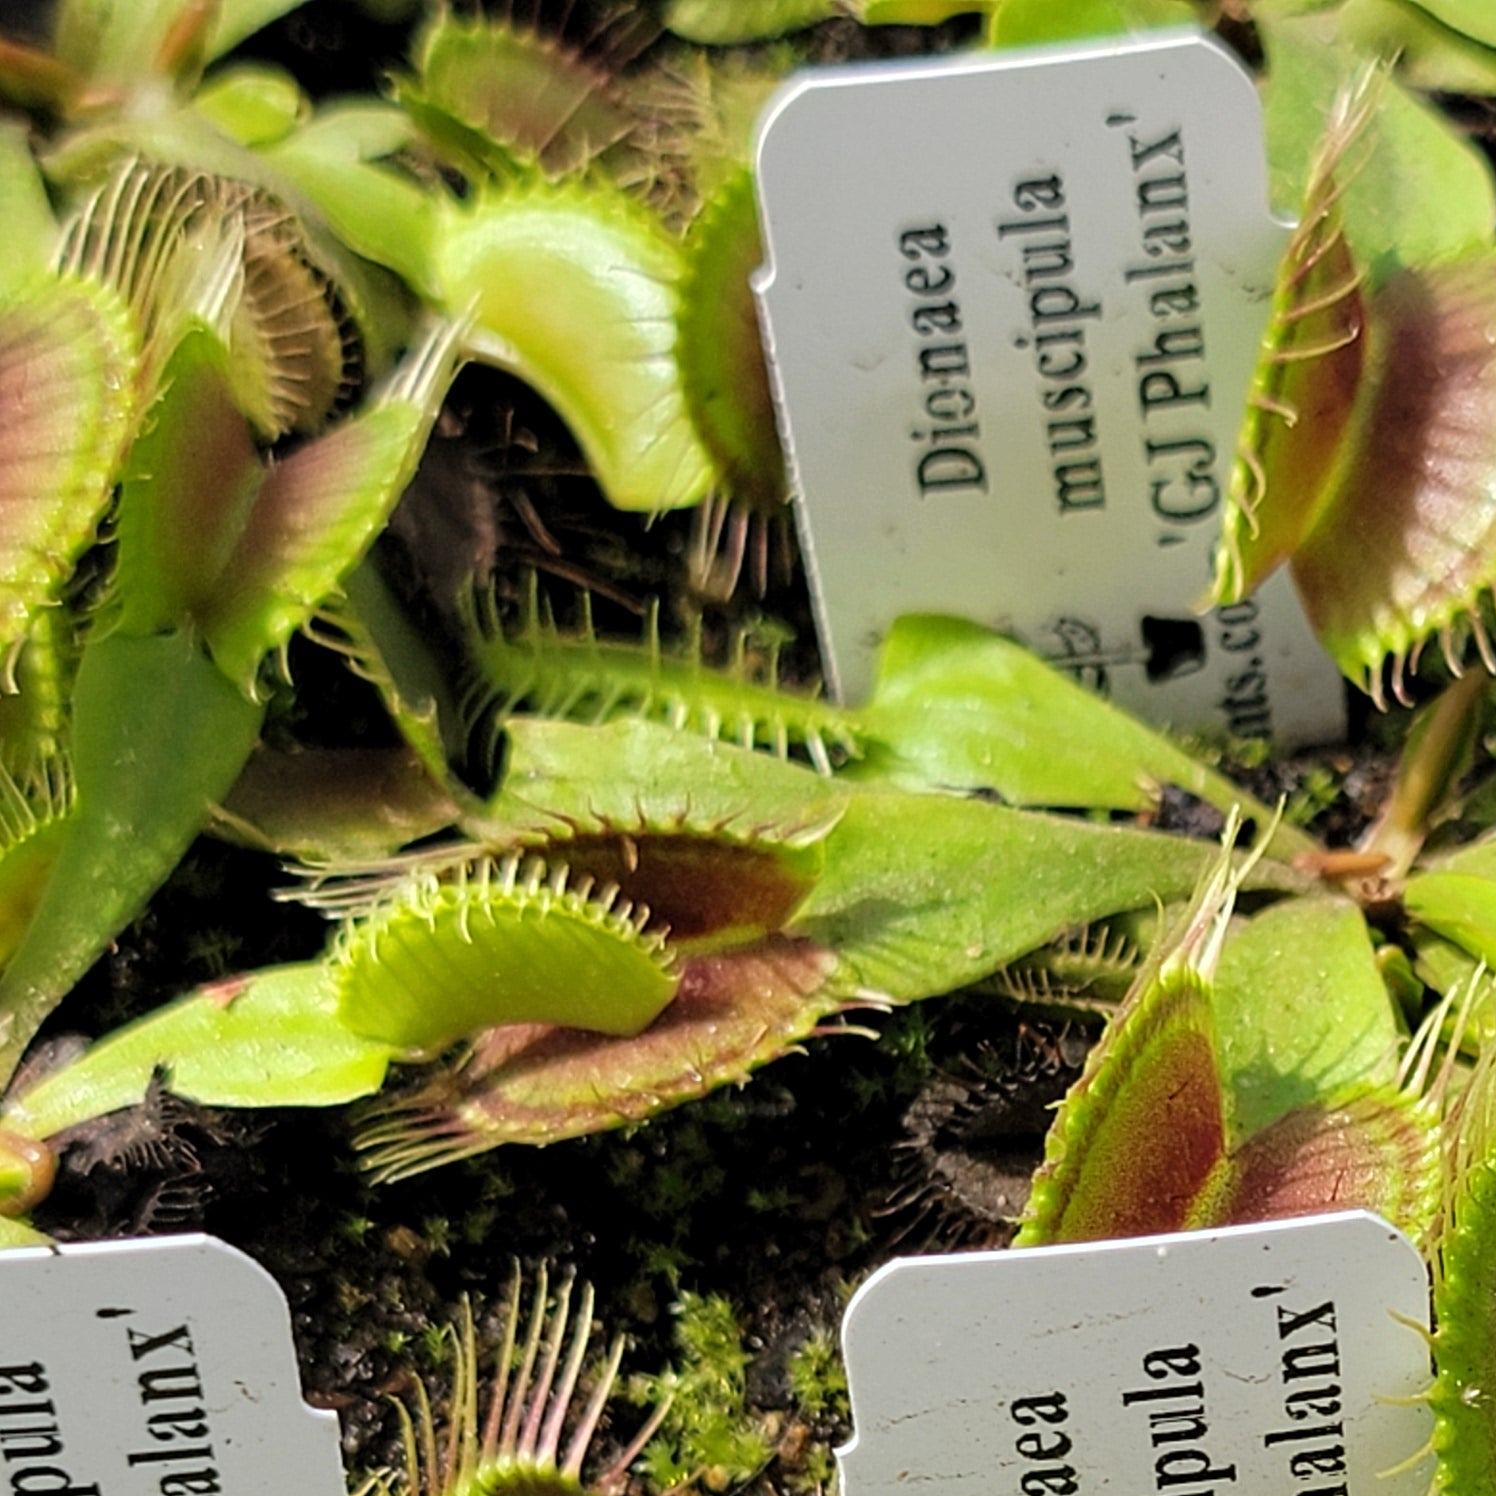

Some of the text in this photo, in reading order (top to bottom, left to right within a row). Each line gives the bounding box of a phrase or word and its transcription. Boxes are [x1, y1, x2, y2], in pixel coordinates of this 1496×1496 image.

[899, 219, 989, 501] Dionaea
[996, 171, 1104, 516] muscipula
[1106, 111, 1211, 422] Phalanx'
